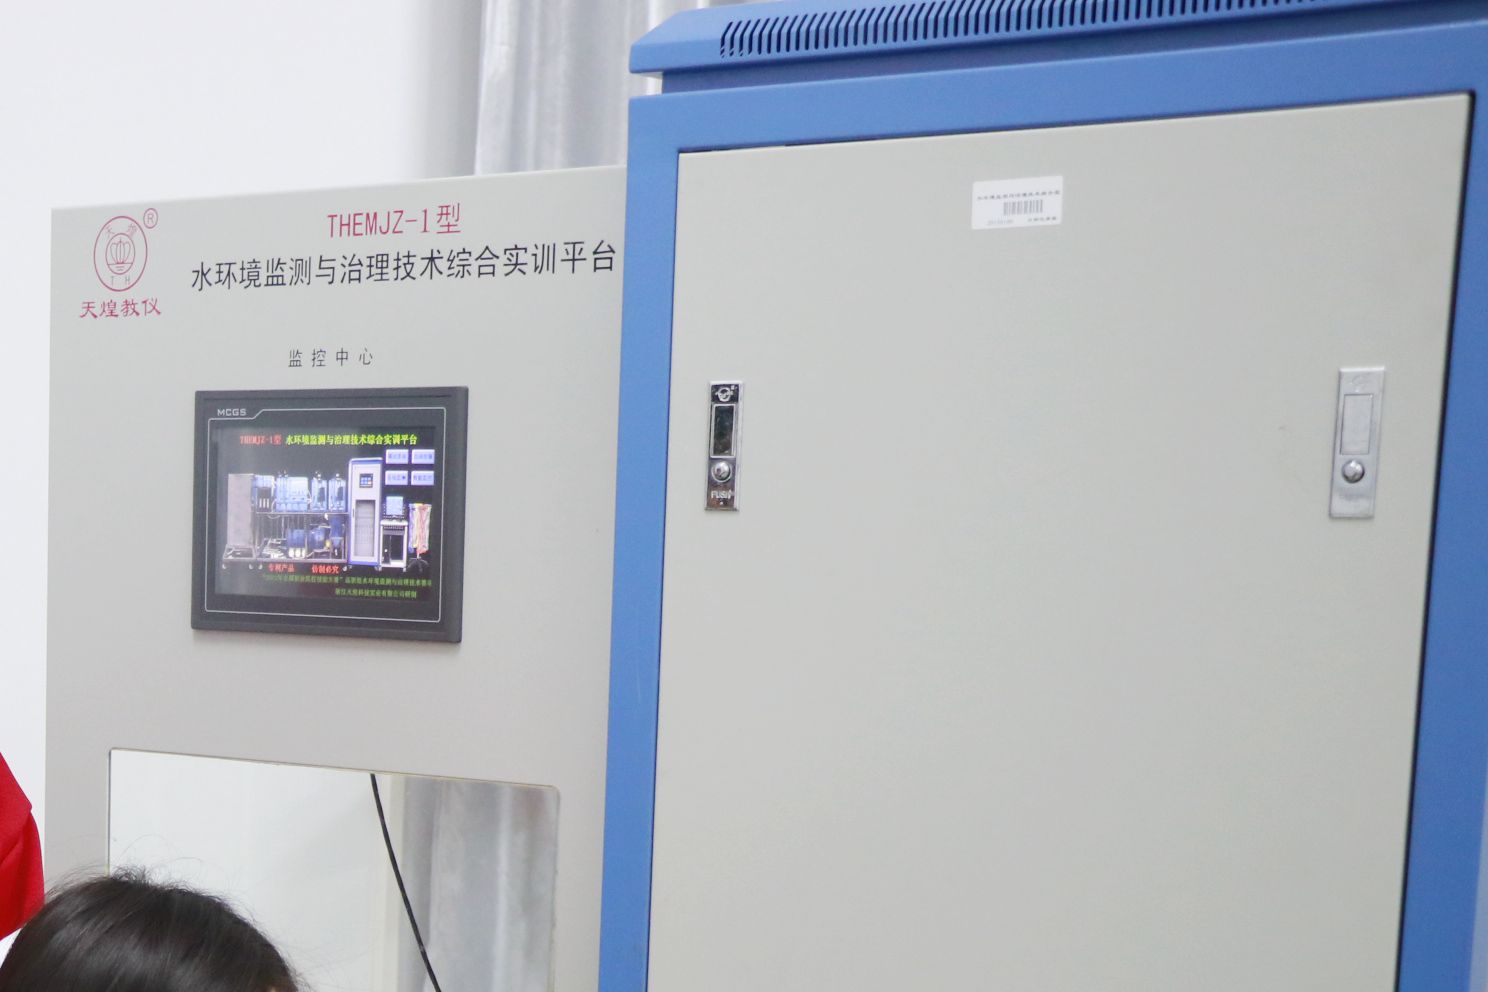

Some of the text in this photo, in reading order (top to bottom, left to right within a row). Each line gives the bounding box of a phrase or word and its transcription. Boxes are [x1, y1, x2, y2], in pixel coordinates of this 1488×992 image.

[327, 202, 462, 238] THEMJZ-1型
[191, 238, 618, 292] 水环境监测与治理技术综合实训平台
[80, 298, 162, 319] 天煌教仪
[288, 347, 373, 368] 监控中心
[216, 407, 248, 417] MCGS
